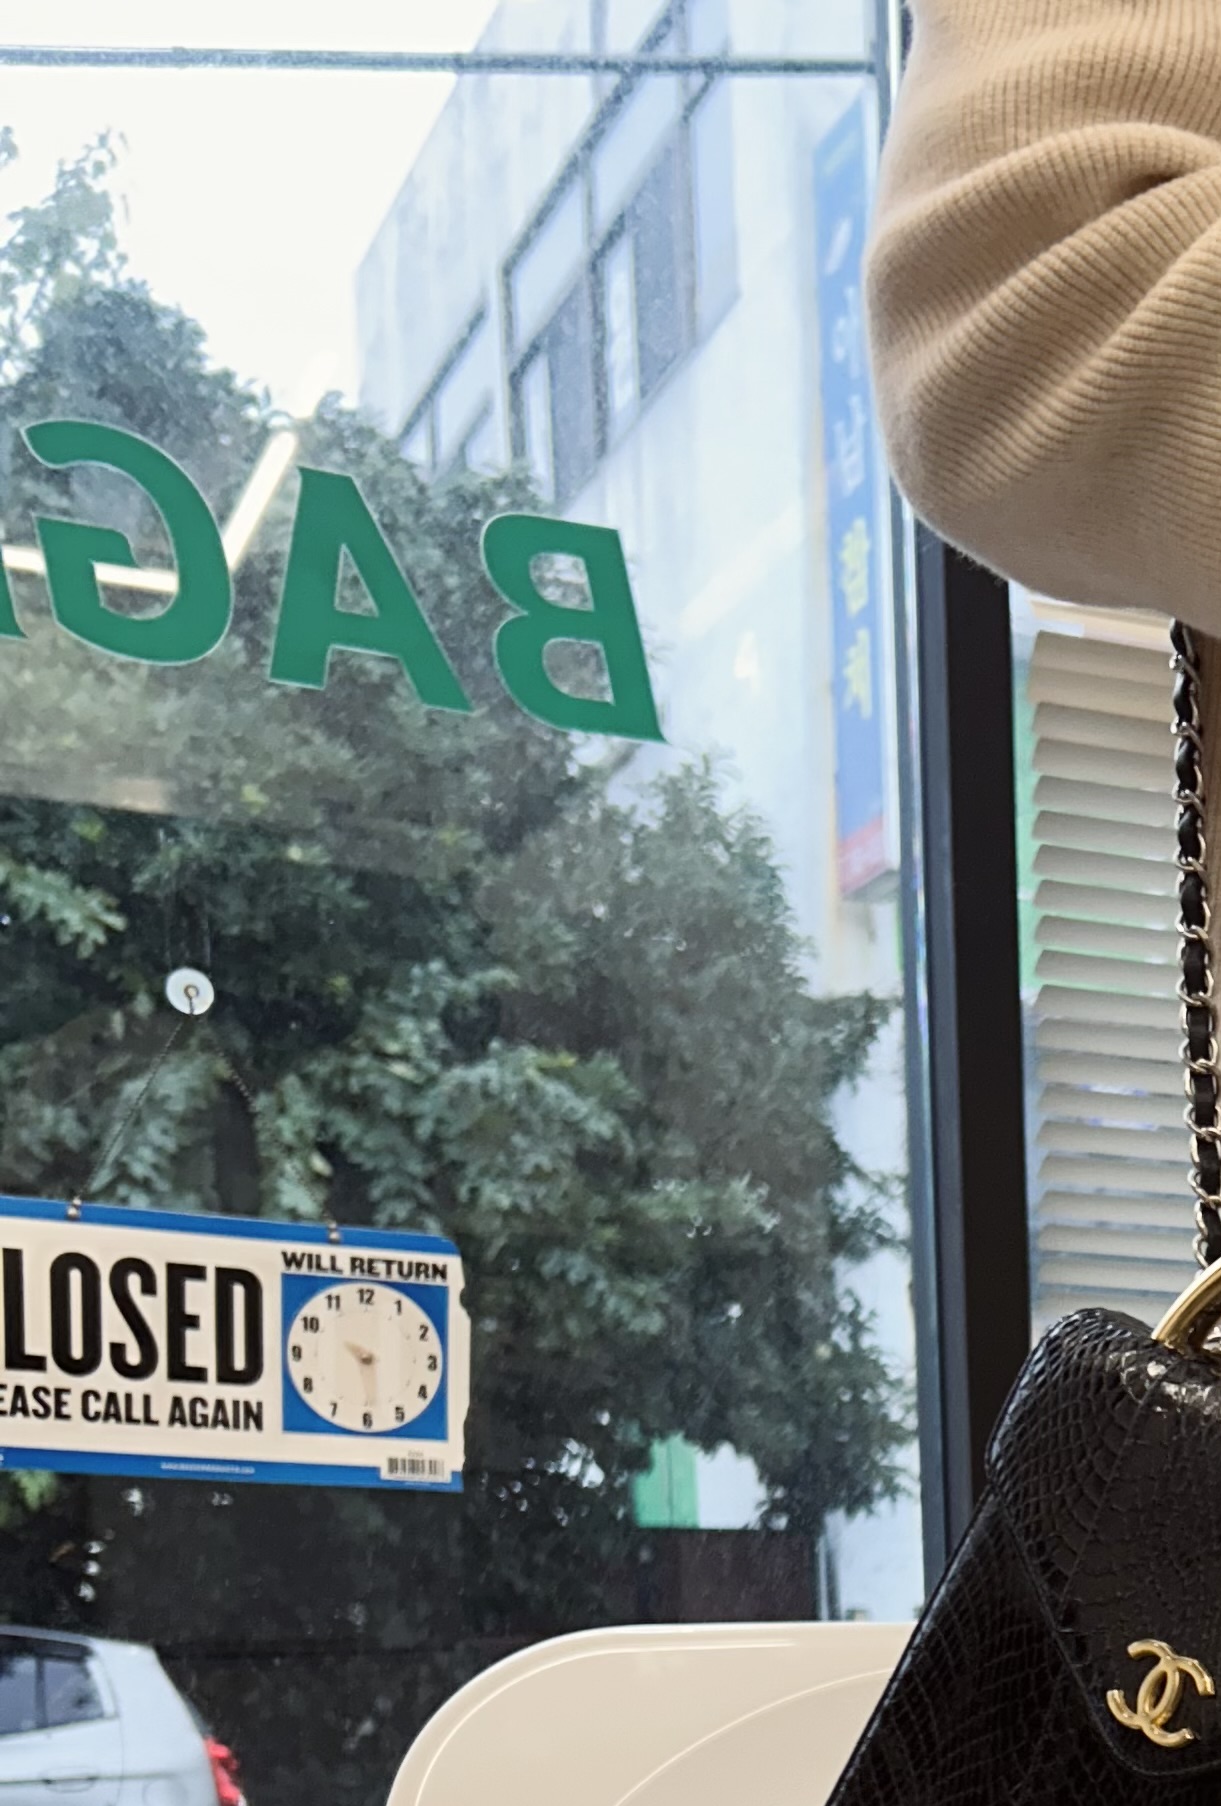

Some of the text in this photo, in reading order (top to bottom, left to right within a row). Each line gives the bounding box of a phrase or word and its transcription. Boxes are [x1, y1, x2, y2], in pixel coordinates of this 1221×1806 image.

[281, 1250, 447, 1281] WILL RETURN
[325, 1294, 341, 1311] 11
[357, 1288, 375, 1305] 12
[394, 1299, 402, 1315] 1
[301, 1316, 320, 1333] 10
[419, 1325, 429, 1341] 2
[291, 1345, 302, 1361] 9
[428, 1355, 437, 1371] 3
[303, 1377, 313, 1393] 8
[417, 1384, 428, 1400] 4
[81, 1389, 158, 1426] CALL
[168, 1396, 264, 1432] AGAIN
[330, 1401, 338, 1417] 7
[395, 1406, 405, 1422] 5
[362, 1412, 372, 1429] 6
